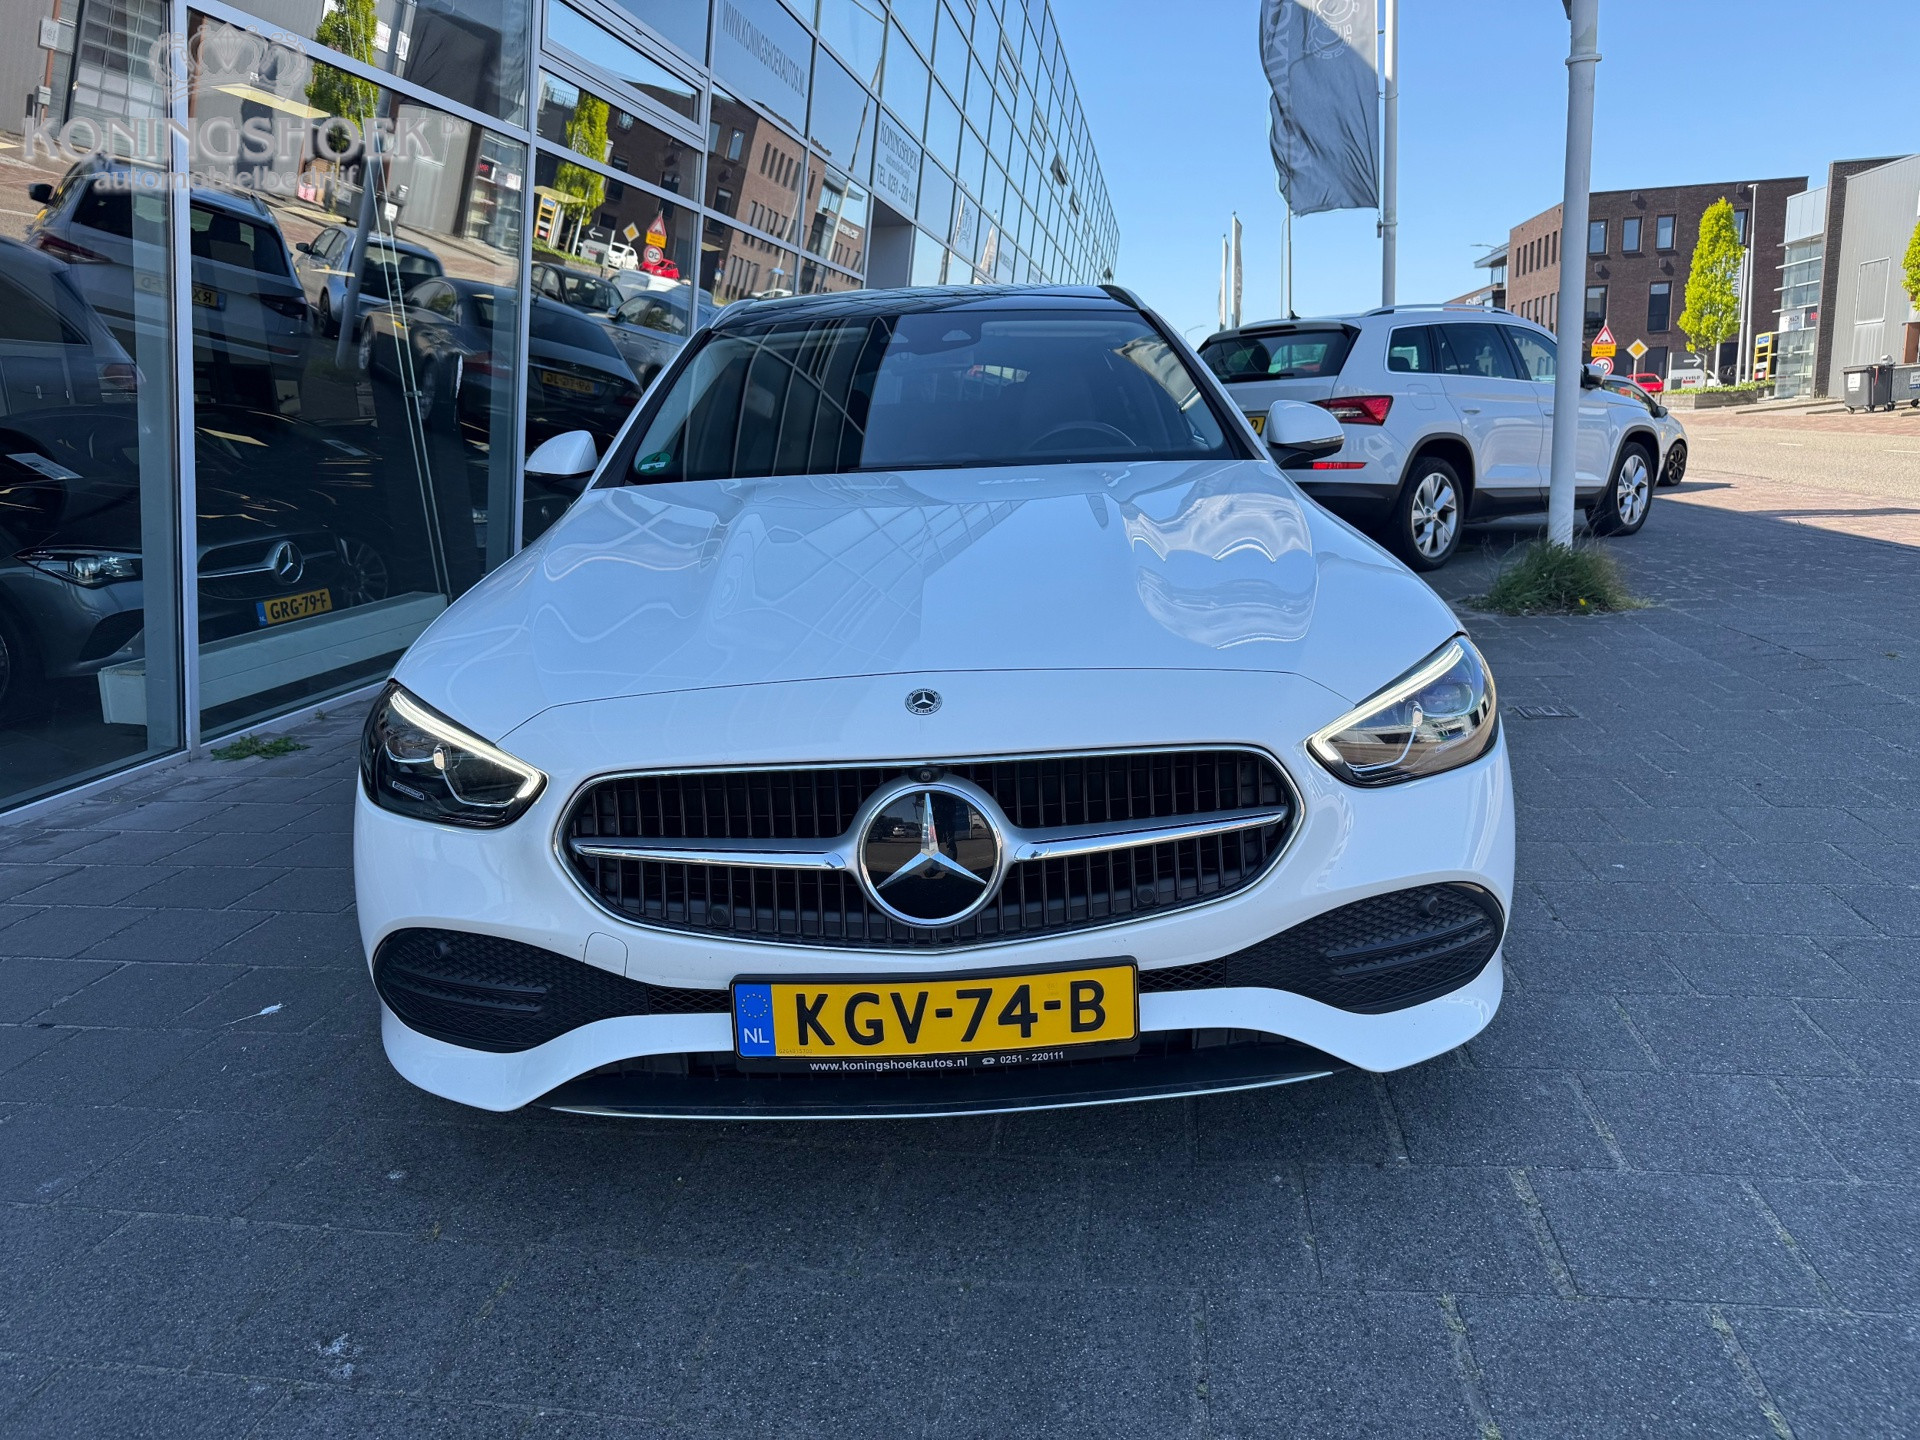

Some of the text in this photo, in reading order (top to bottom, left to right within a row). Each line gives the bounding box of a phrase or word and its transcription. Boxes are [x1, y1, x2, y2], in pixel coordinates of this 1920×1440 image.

[270, 592, 327, 619] GRG-79-F
[744, 980, 1106, 1046] NL KGV-74-B
[810, 1057, 968, 1072] www.koningshoekautos.nl
[1000, 1055, 1023, 1064] 0251
[1032, 1051, 1064, 1062] 220111
